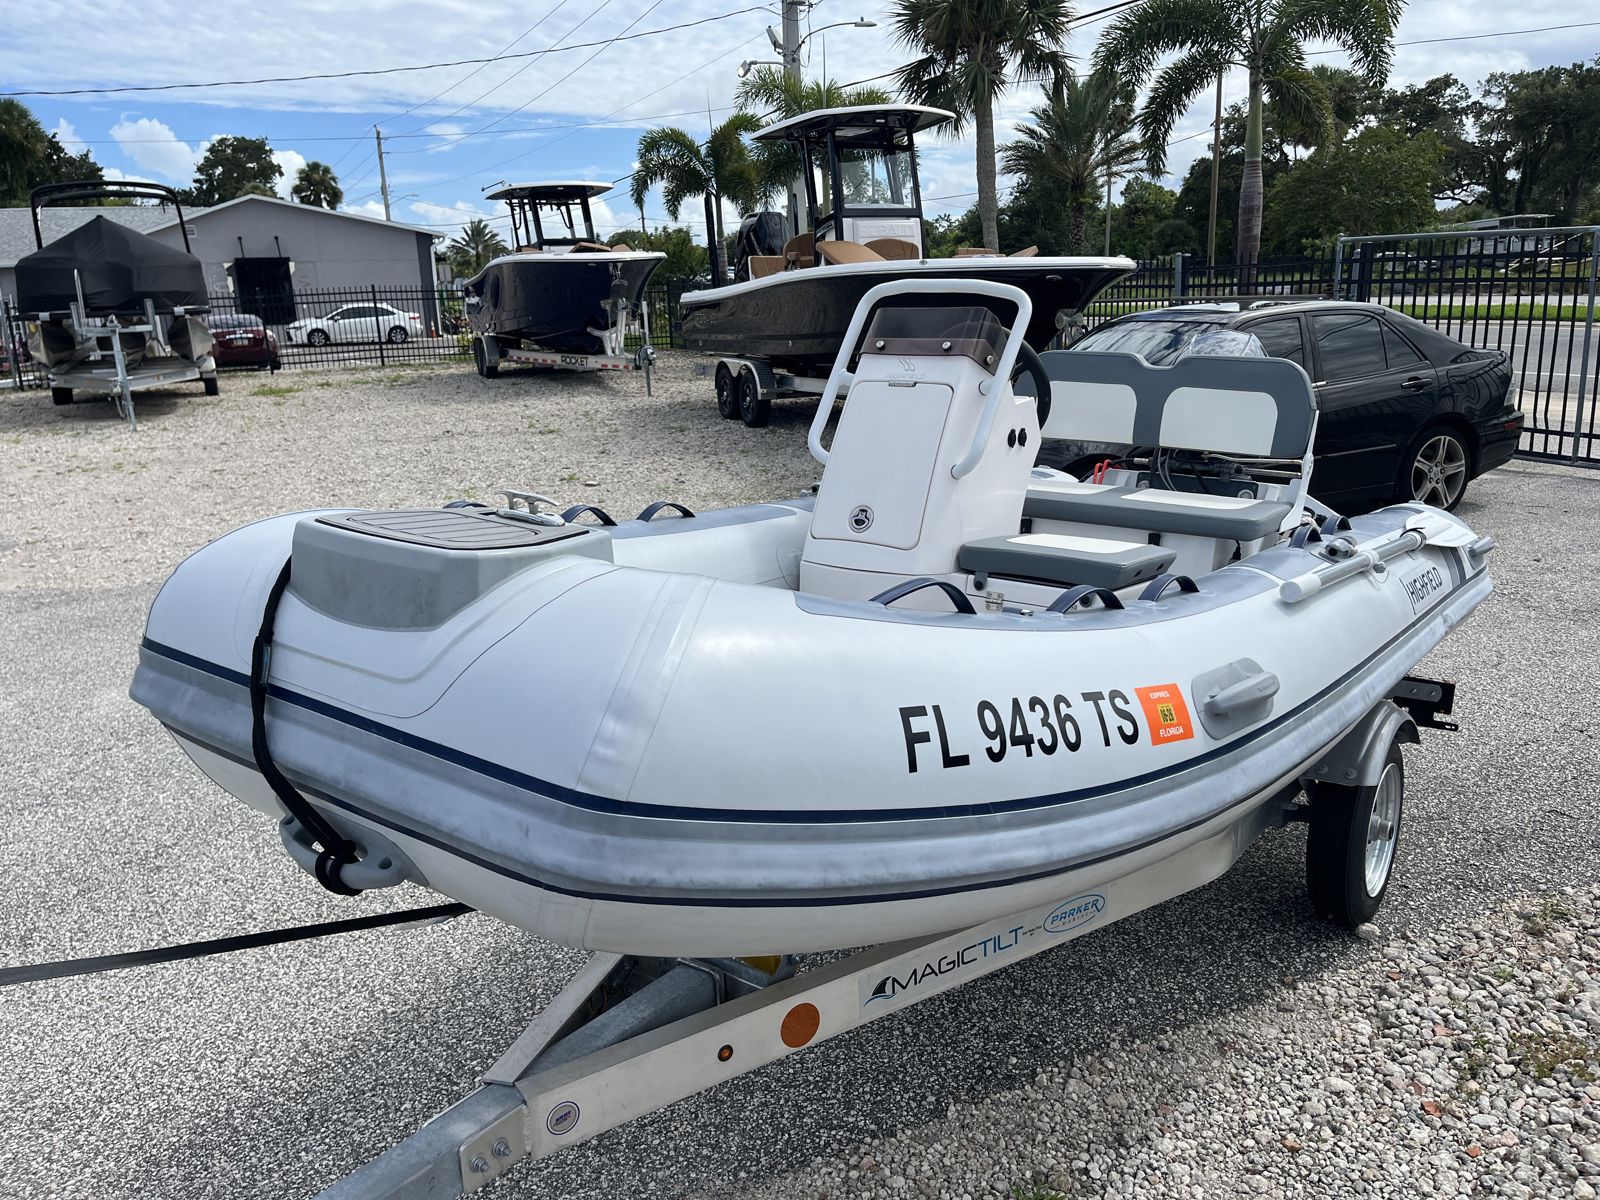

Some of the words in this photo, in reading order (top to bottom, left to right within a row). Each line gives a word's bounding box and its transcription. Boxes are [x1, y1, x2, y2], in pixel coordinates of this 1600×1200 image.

[561, 355, 588, 366] ROCKET
[1405, 566, 1443, 606] HIGHFIELD
[898, 704, 971, 774] FL
[976, 693, 1082, 763] 9436
[1080, 689, 1140, 748] TS
[1160, 726, 1184, 738] FLORIDA
[1050, 898, 1101, 925] PARKER
